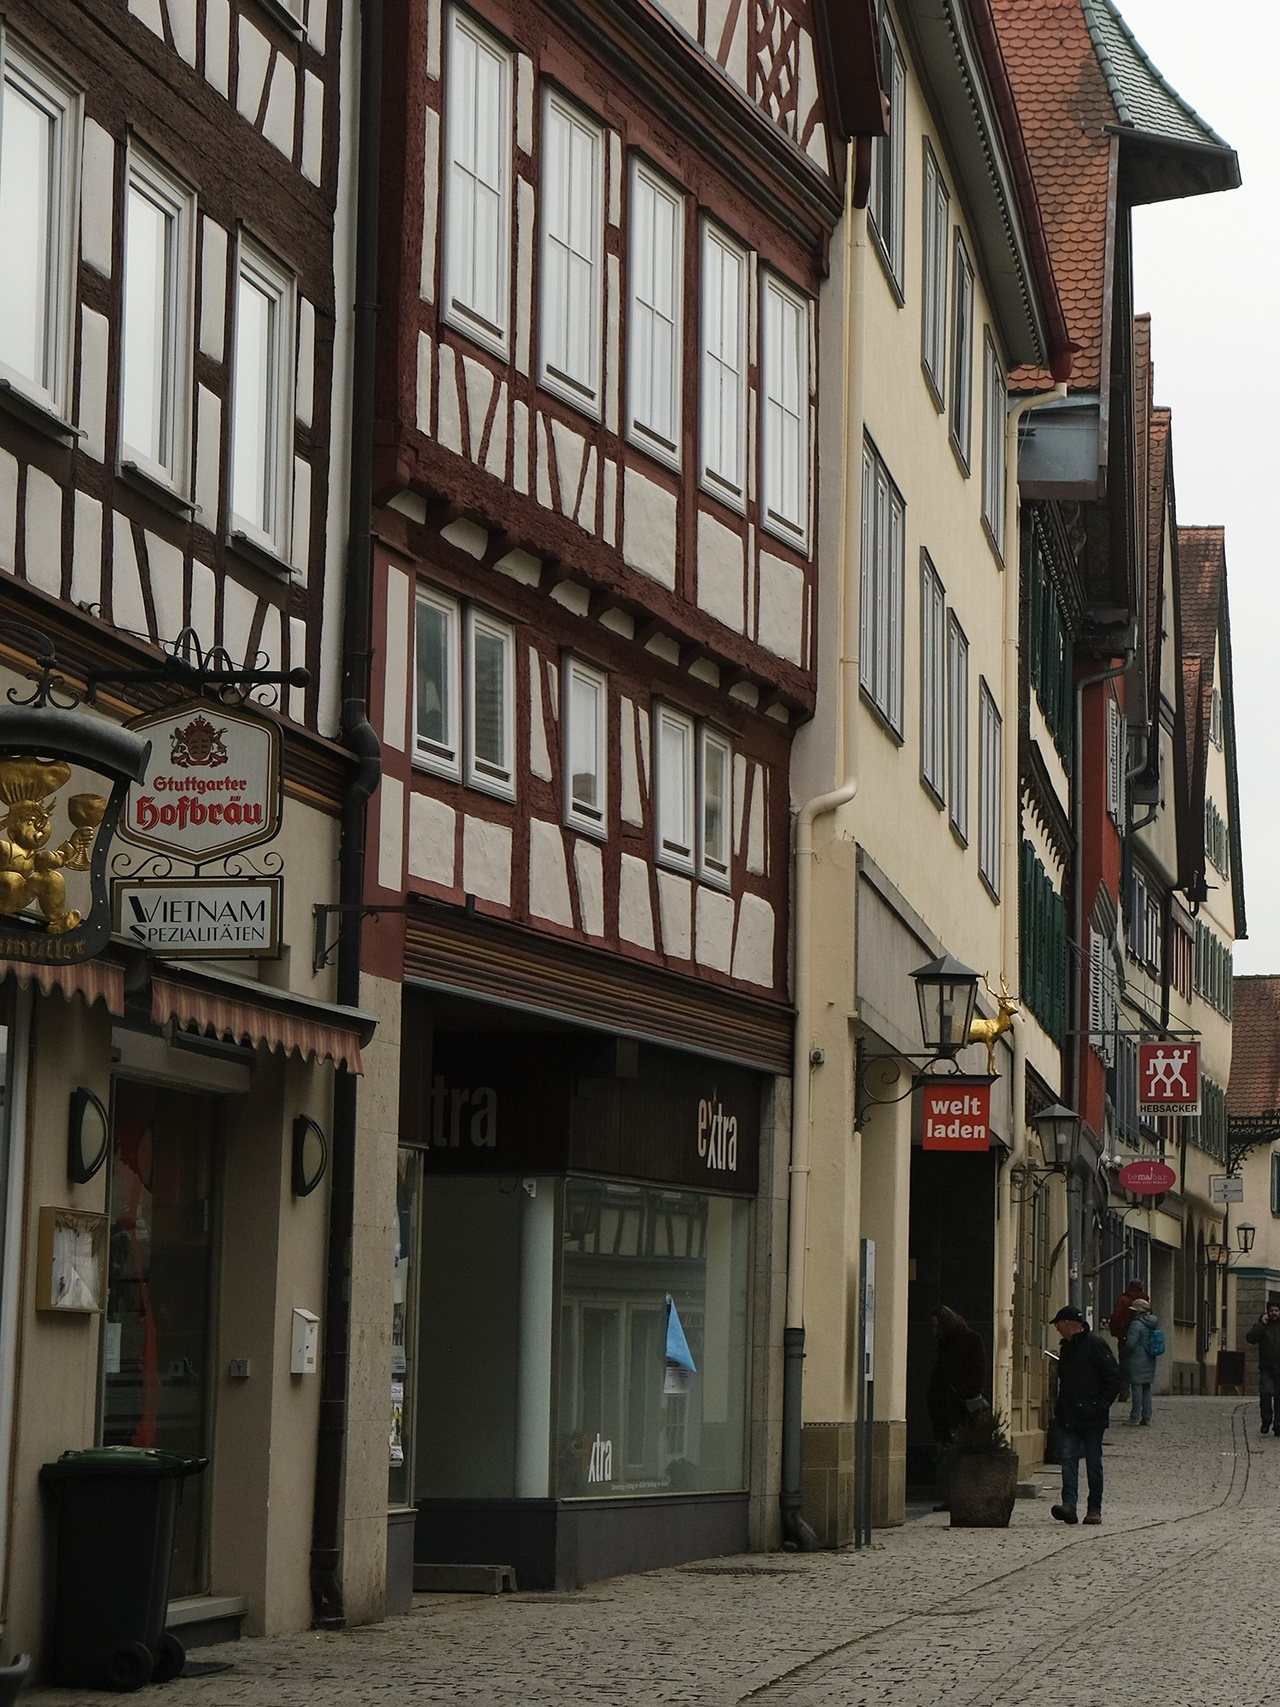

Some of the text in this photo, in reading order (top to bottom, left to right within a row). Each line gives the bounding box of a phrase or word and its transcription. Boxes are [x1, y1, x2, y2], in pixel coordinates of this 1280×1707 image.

[153, 775, 247, 795] Stuttgarter
[136, 795, 263, 831] Hofbräu
[128, 895, 265, 923] VIETNAM
[129, 924, 265, 943] SPEZIALITÄTEN
[431, 1075, 497, 1148] tra
[930, 1095, 981, 1116] welt
[1140, 1104, 1198, 1113] HEBSACKER
[698, 1098, 738, 1172] extra
[926, 1118, 986, 1139] laden
